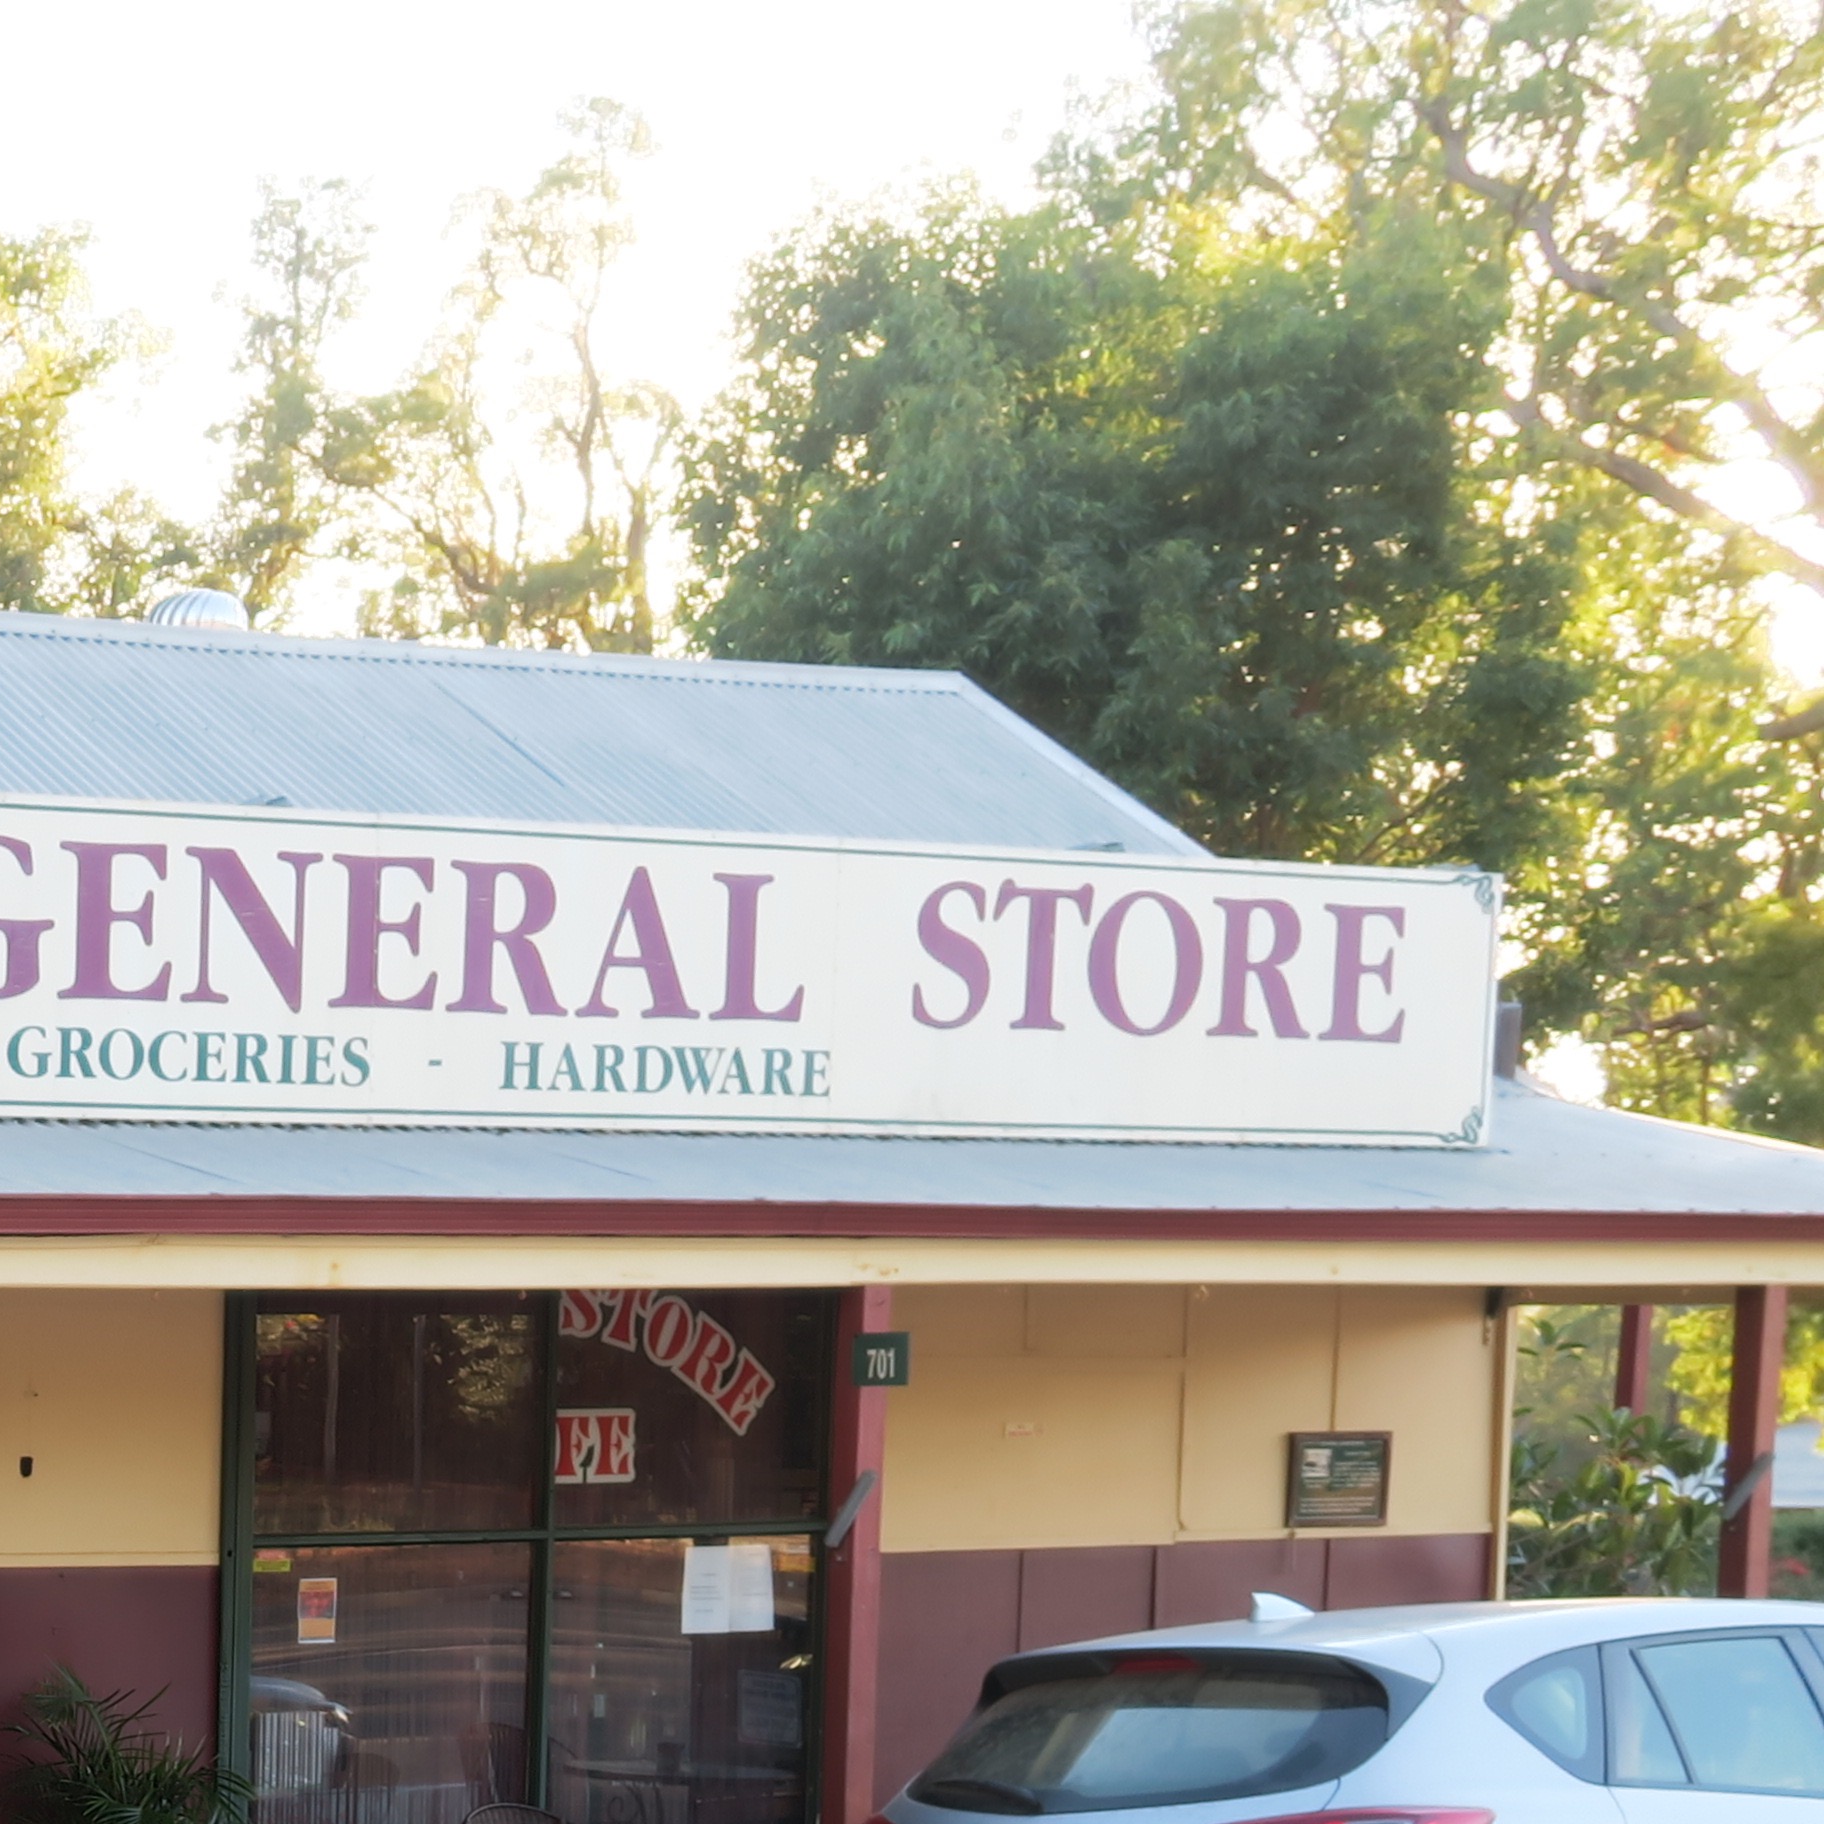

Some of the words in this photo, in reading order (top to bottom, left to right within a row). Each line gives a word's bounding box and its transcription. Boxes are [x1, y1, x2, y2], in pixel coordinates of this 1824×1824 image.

[911, 877, 1406, 1044] STORE
[5, 1024, 371, 1087] GROCERIES
[497, 1040, 832, 1099] HARDWARE
[557, 1288, 776, 1437] STORE
[866, 1347, 896, 1380] 701
